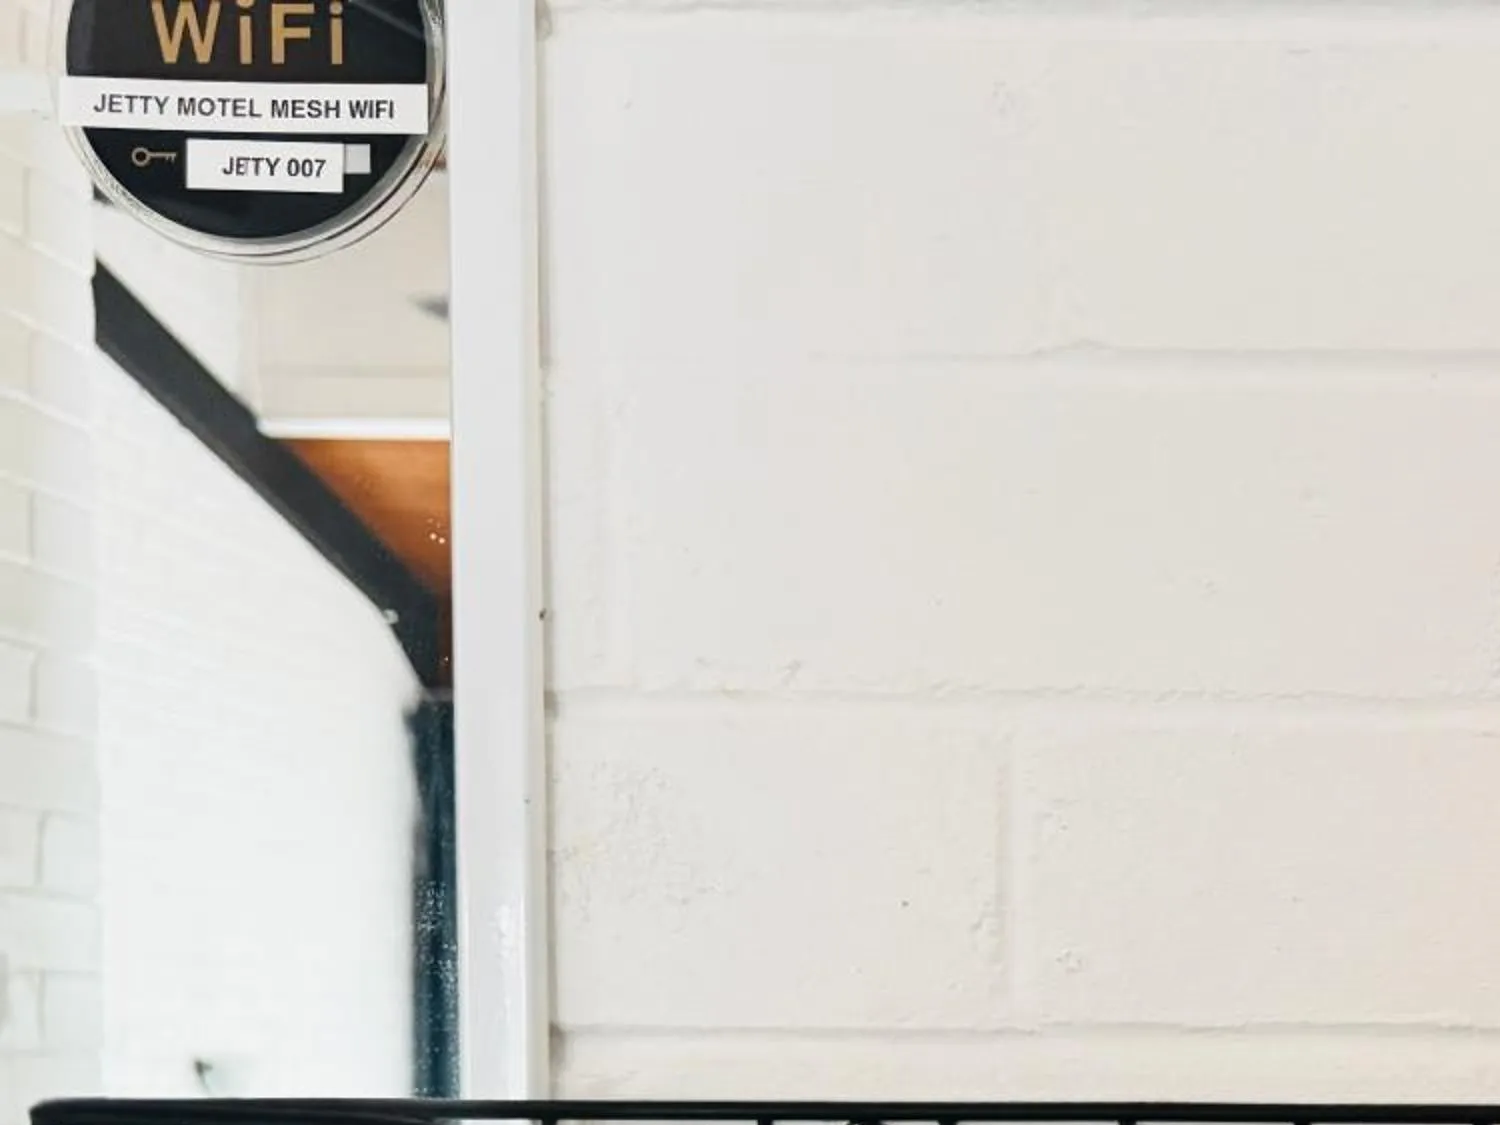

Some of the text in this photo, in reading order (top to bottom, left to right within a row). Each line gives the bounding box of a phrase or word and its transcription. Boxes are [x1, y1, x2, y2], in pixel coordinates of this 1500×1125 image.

[151, 0, 344, 64] WiFi
[93, 93, 395, 120] JETTY MOTEL MESH WIFI
[222, 157, 326, 178] JETY 007
